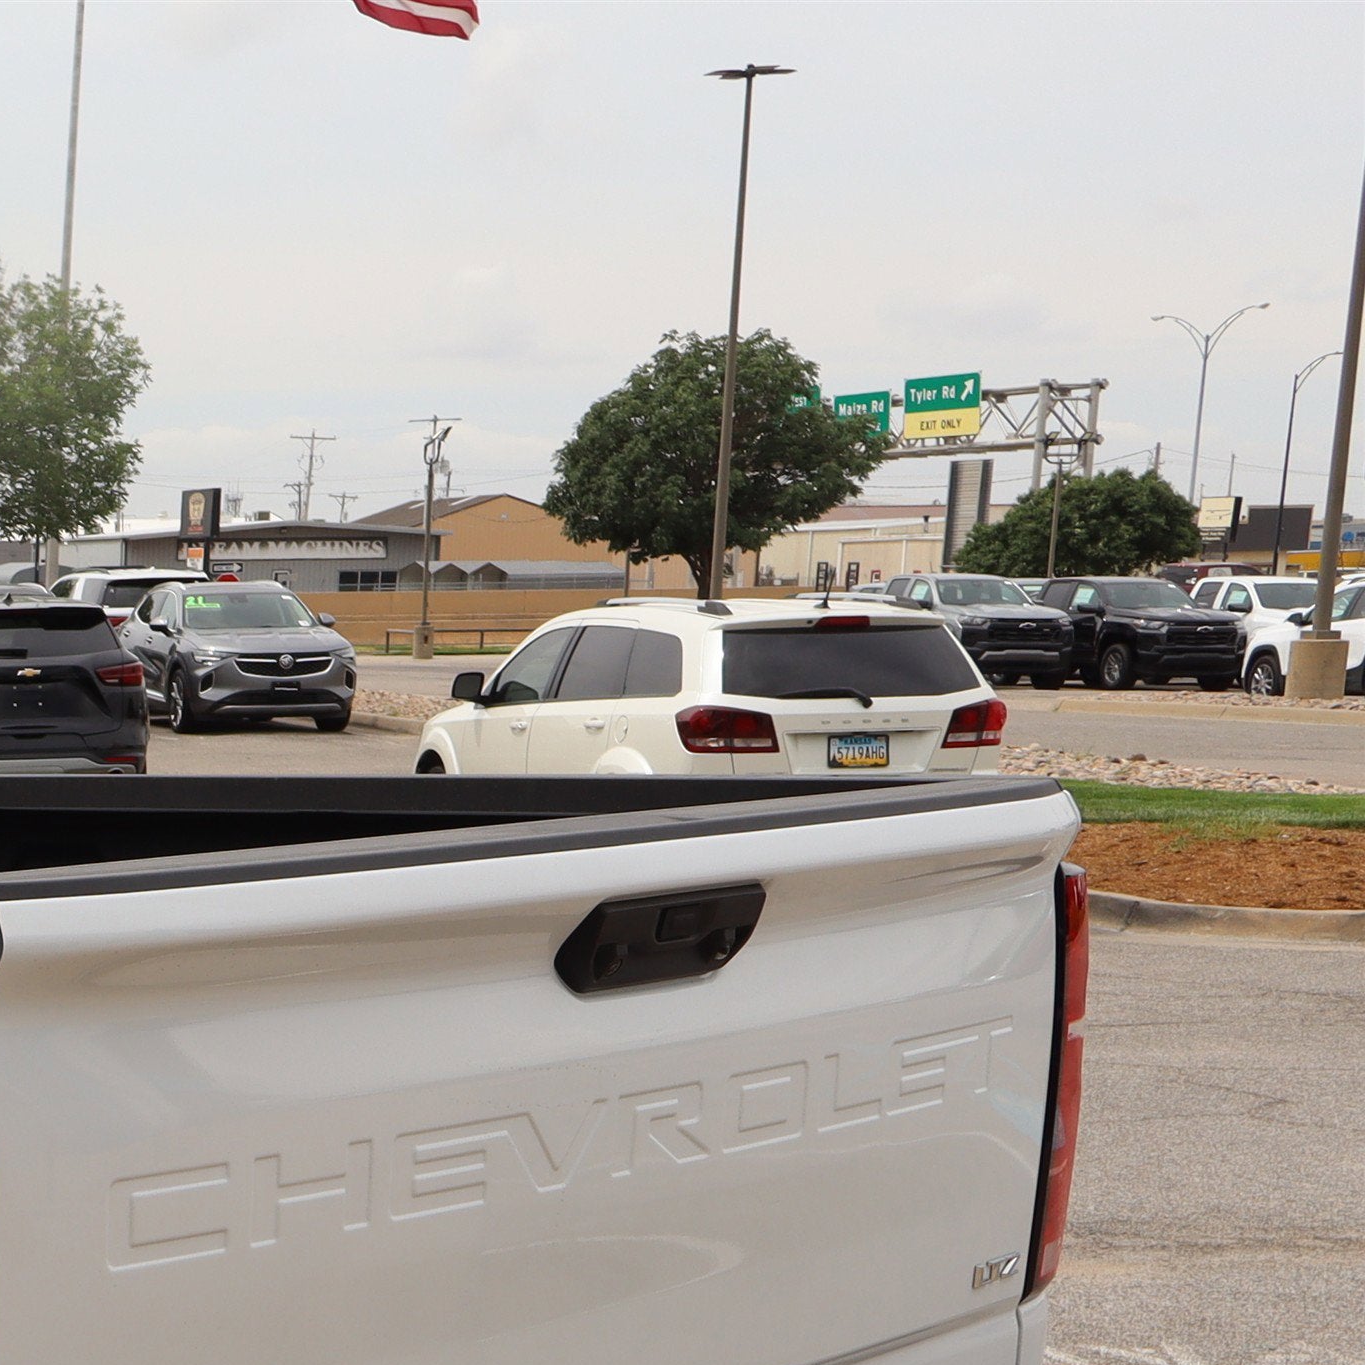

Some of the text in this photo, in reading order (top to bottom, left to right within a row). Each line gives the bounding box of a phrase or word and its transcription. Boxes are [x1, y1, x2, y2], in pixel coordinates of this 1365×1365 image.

[910, 385, 956, 405] Tyler Rd
[838, 400, 884, 416] Maize Rd
[920, 418, 962, 431] EXIT ONLY
[269, 541, 384, 554] MACHINES
[836, 746, 885, 761] 5719AHG
[107, 1014, 1014, 1272] CHEVROLET
[972, 1250, 1020, 1290] LTZ
